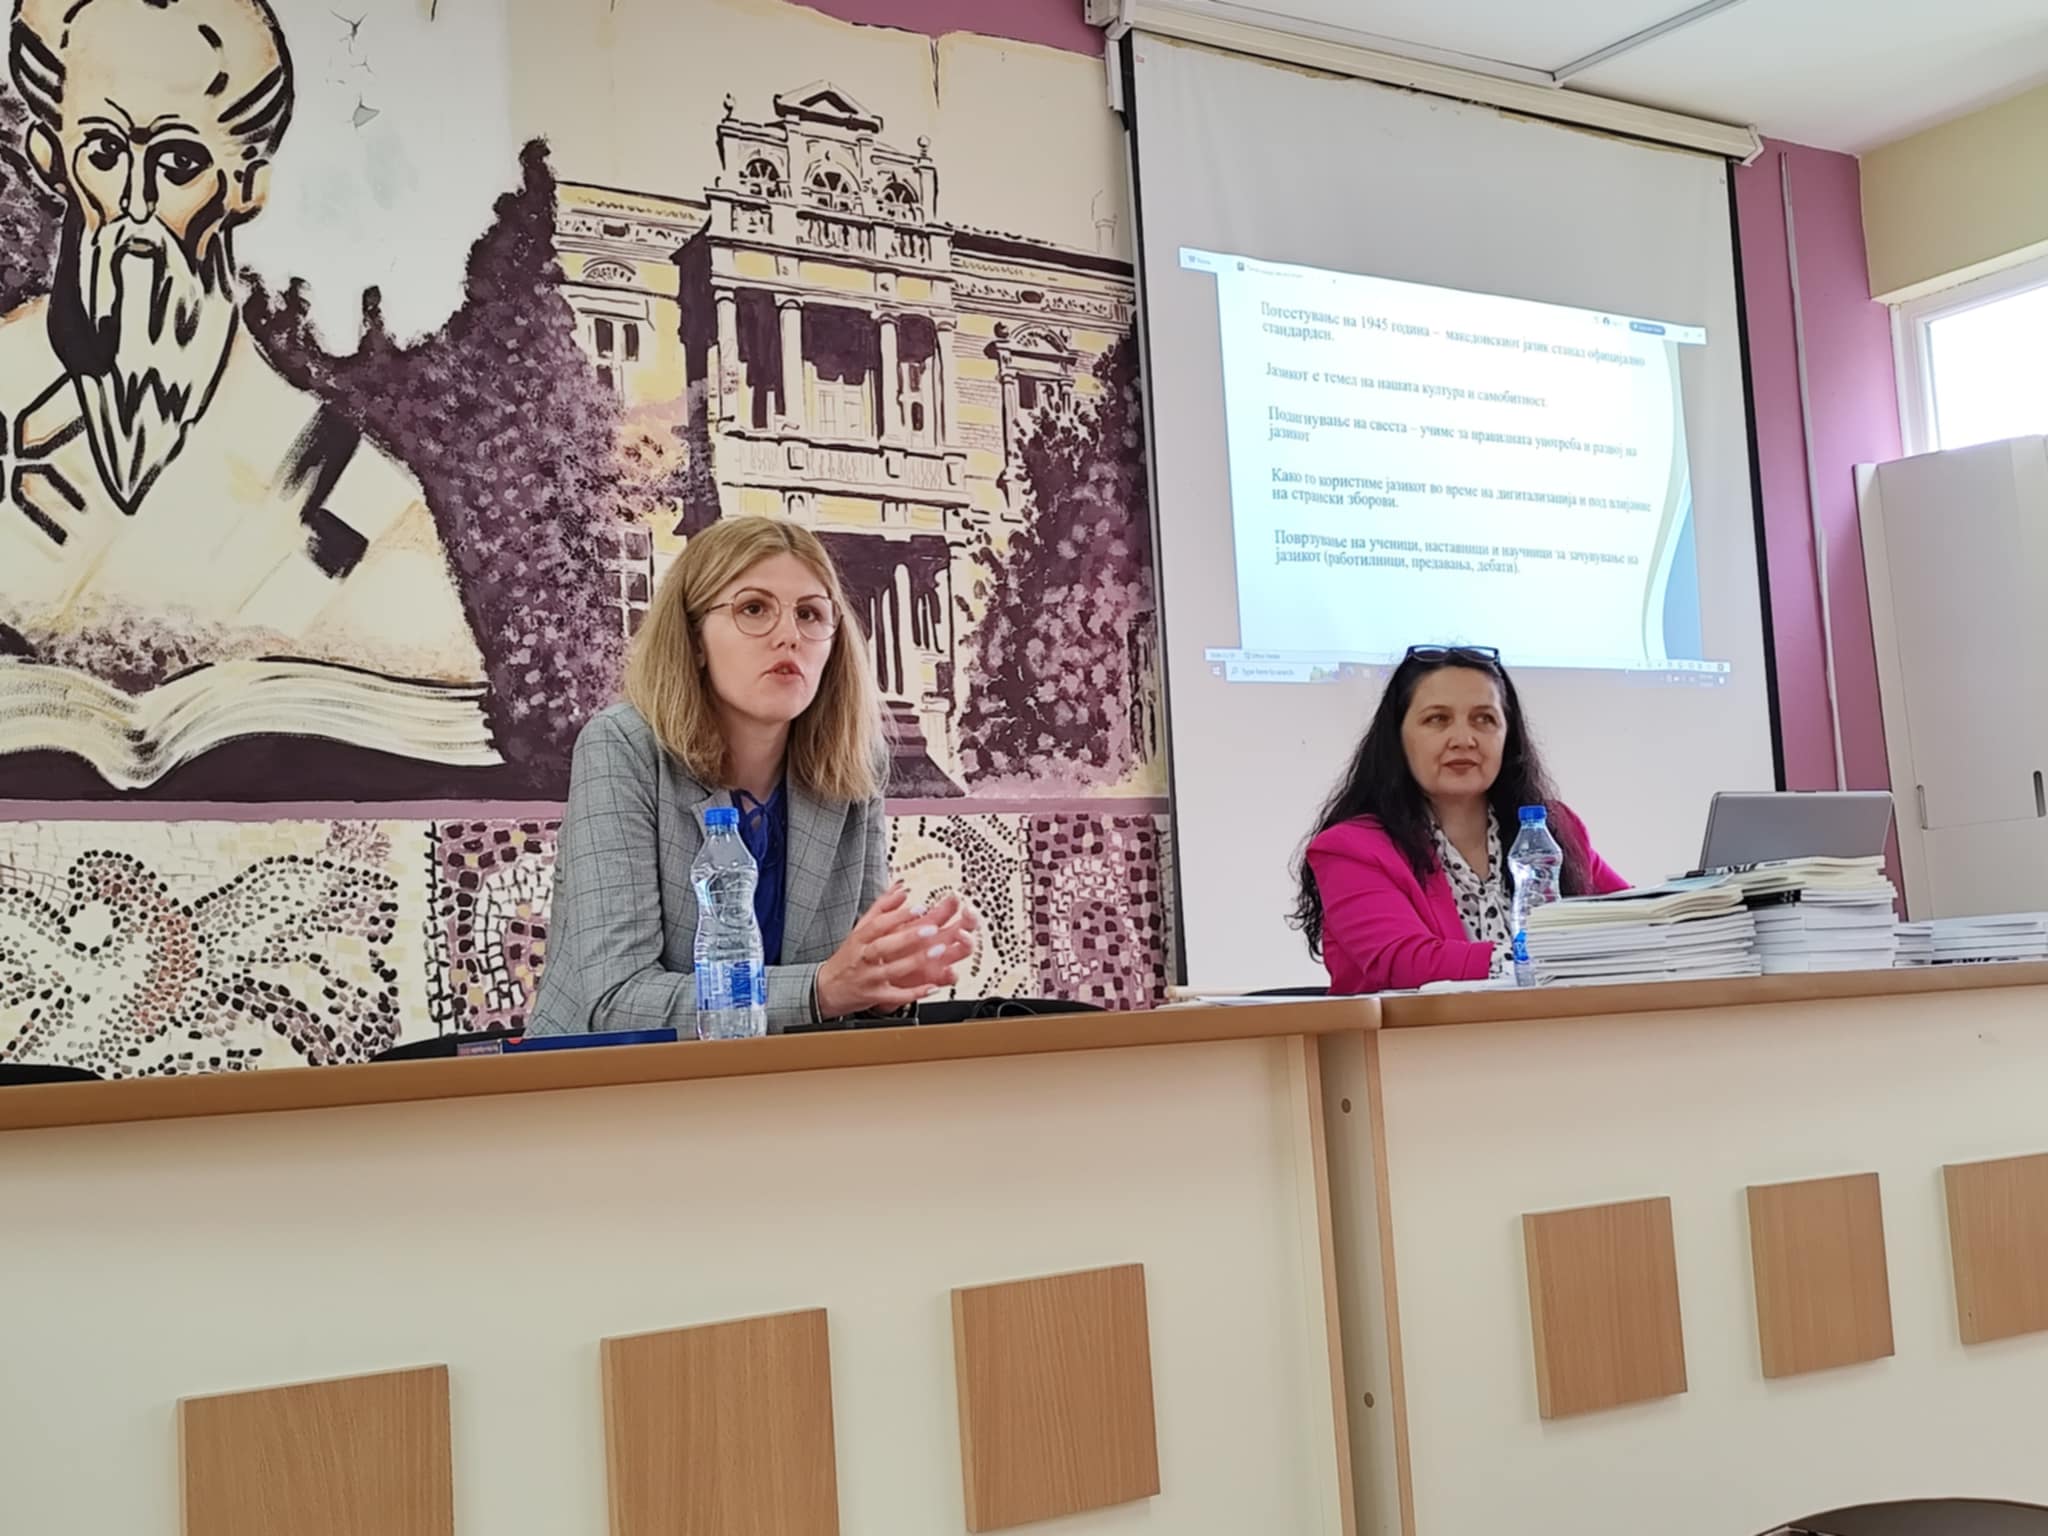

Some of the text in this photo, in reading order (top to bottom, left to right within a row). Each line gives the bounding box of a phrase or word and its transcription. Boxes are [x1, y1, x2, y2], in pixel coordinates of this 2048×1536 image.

[1343, 315, 1357, 328] на
[1362, 316, 1388, 331] 1945
[1392, 322, 1429, 337] година
[1523, 336, 1548, 353] јазик
[1266, 362, 1308, 382] Јазикот
[1312, 371, 1320, 382] е
[1324, 372, 1357, 386] темел
[1361, 378, 1374, 388] на
[1378, 379, 1419, 393] нашата
[1423, 384, 1465, 400] култура
[1468, 389, 1474, 399] и
[1268, 423, 1309, 442] јазикот
[1354, 417, 1367, 429] на
[1370, 420, 1407, 433] свеста
[1420, 425, 1453, 438] учиме
[1458, 428, 1468, 440] за
[1535, 436, 1581, 452] употреба
[1584, 442, 1590, 452] и
[1626, 446, 1637, 457] на
[1272, 468, 1302, 482] Како
[1305, 474, 1316, 485] го
[1319, 475, 1383, 490] користиме
[1386, 476, 1426, 493] јазикот
[1430, 484, 1443, 494] во
[1446, 484, 1478, 498] време
[1481, 487, 1493, 498] на
[1580, 495, 1586, 506] и
[1589, 497, 1607, 508] под
[1273, 489, 1399, 508] на странски зборови.
[1275, 530, 1347, 549] Поврзување
[1351, 537, 1365, 549] на
[1369, 538, 1422, 552] ученици,
[1493, 544, 1499, 555] и
[1557, 548, 1565, 559] за
[1628, 553, 1638, 565] на
[1275, 547, 1321, 565] јазикот
